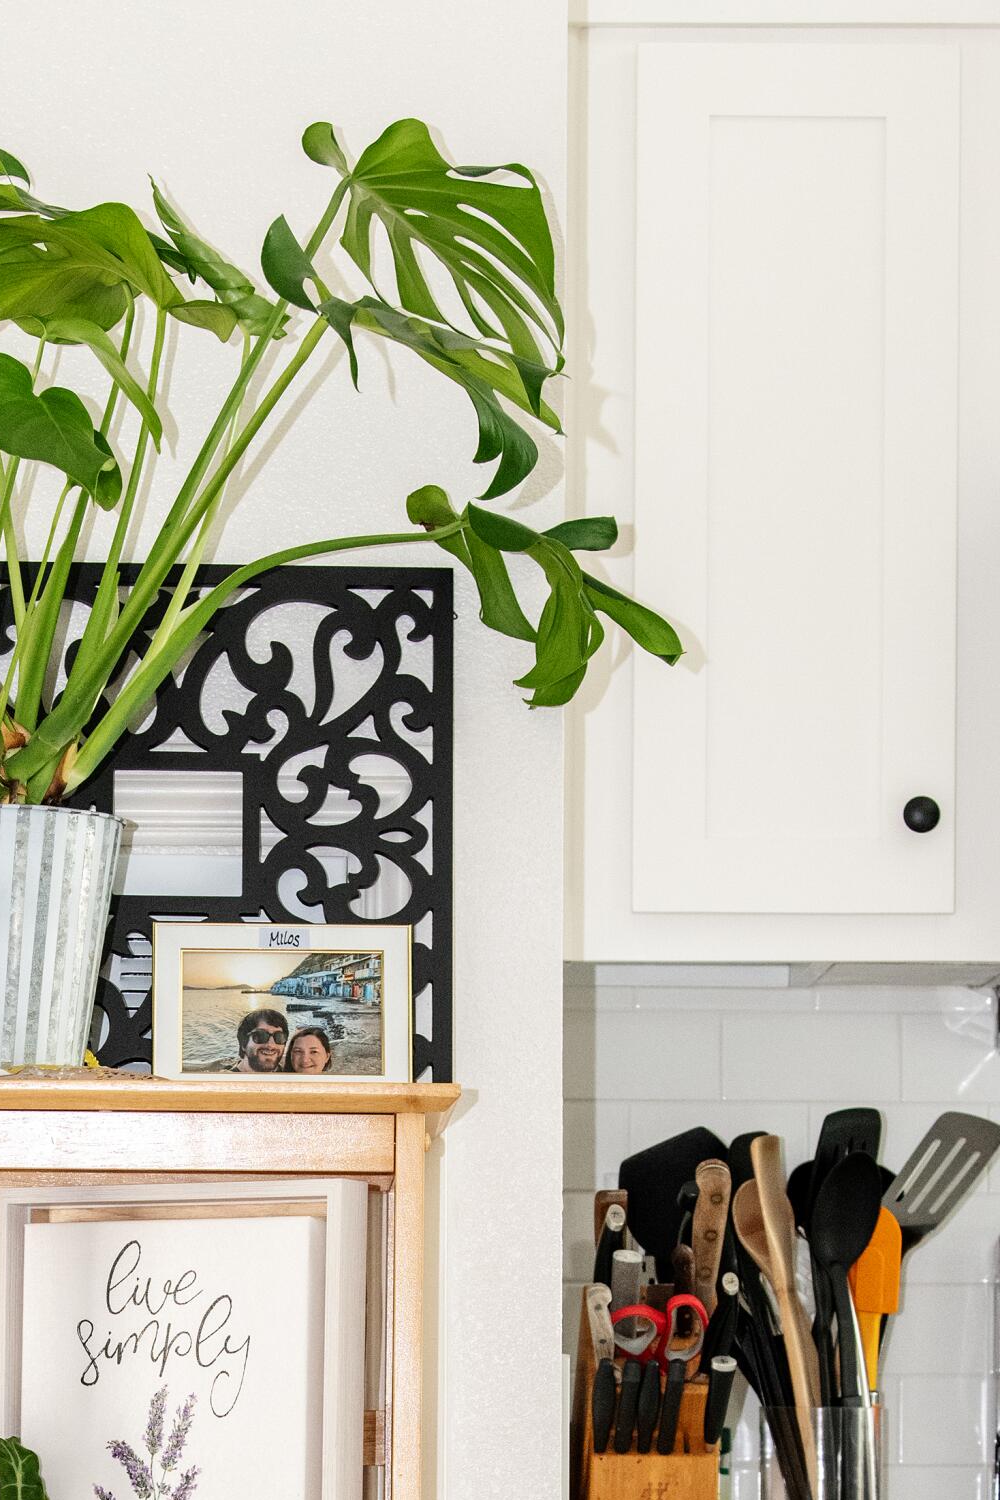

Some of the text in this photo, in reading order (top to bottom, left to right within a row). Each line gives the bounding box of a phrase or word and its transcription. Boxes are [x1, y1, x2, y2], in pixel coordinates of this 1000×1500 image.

[268, 930, 300, 948] Milos
[106, 1239, 203, 1316] live
[76, 1294, 251, 1418] simply
